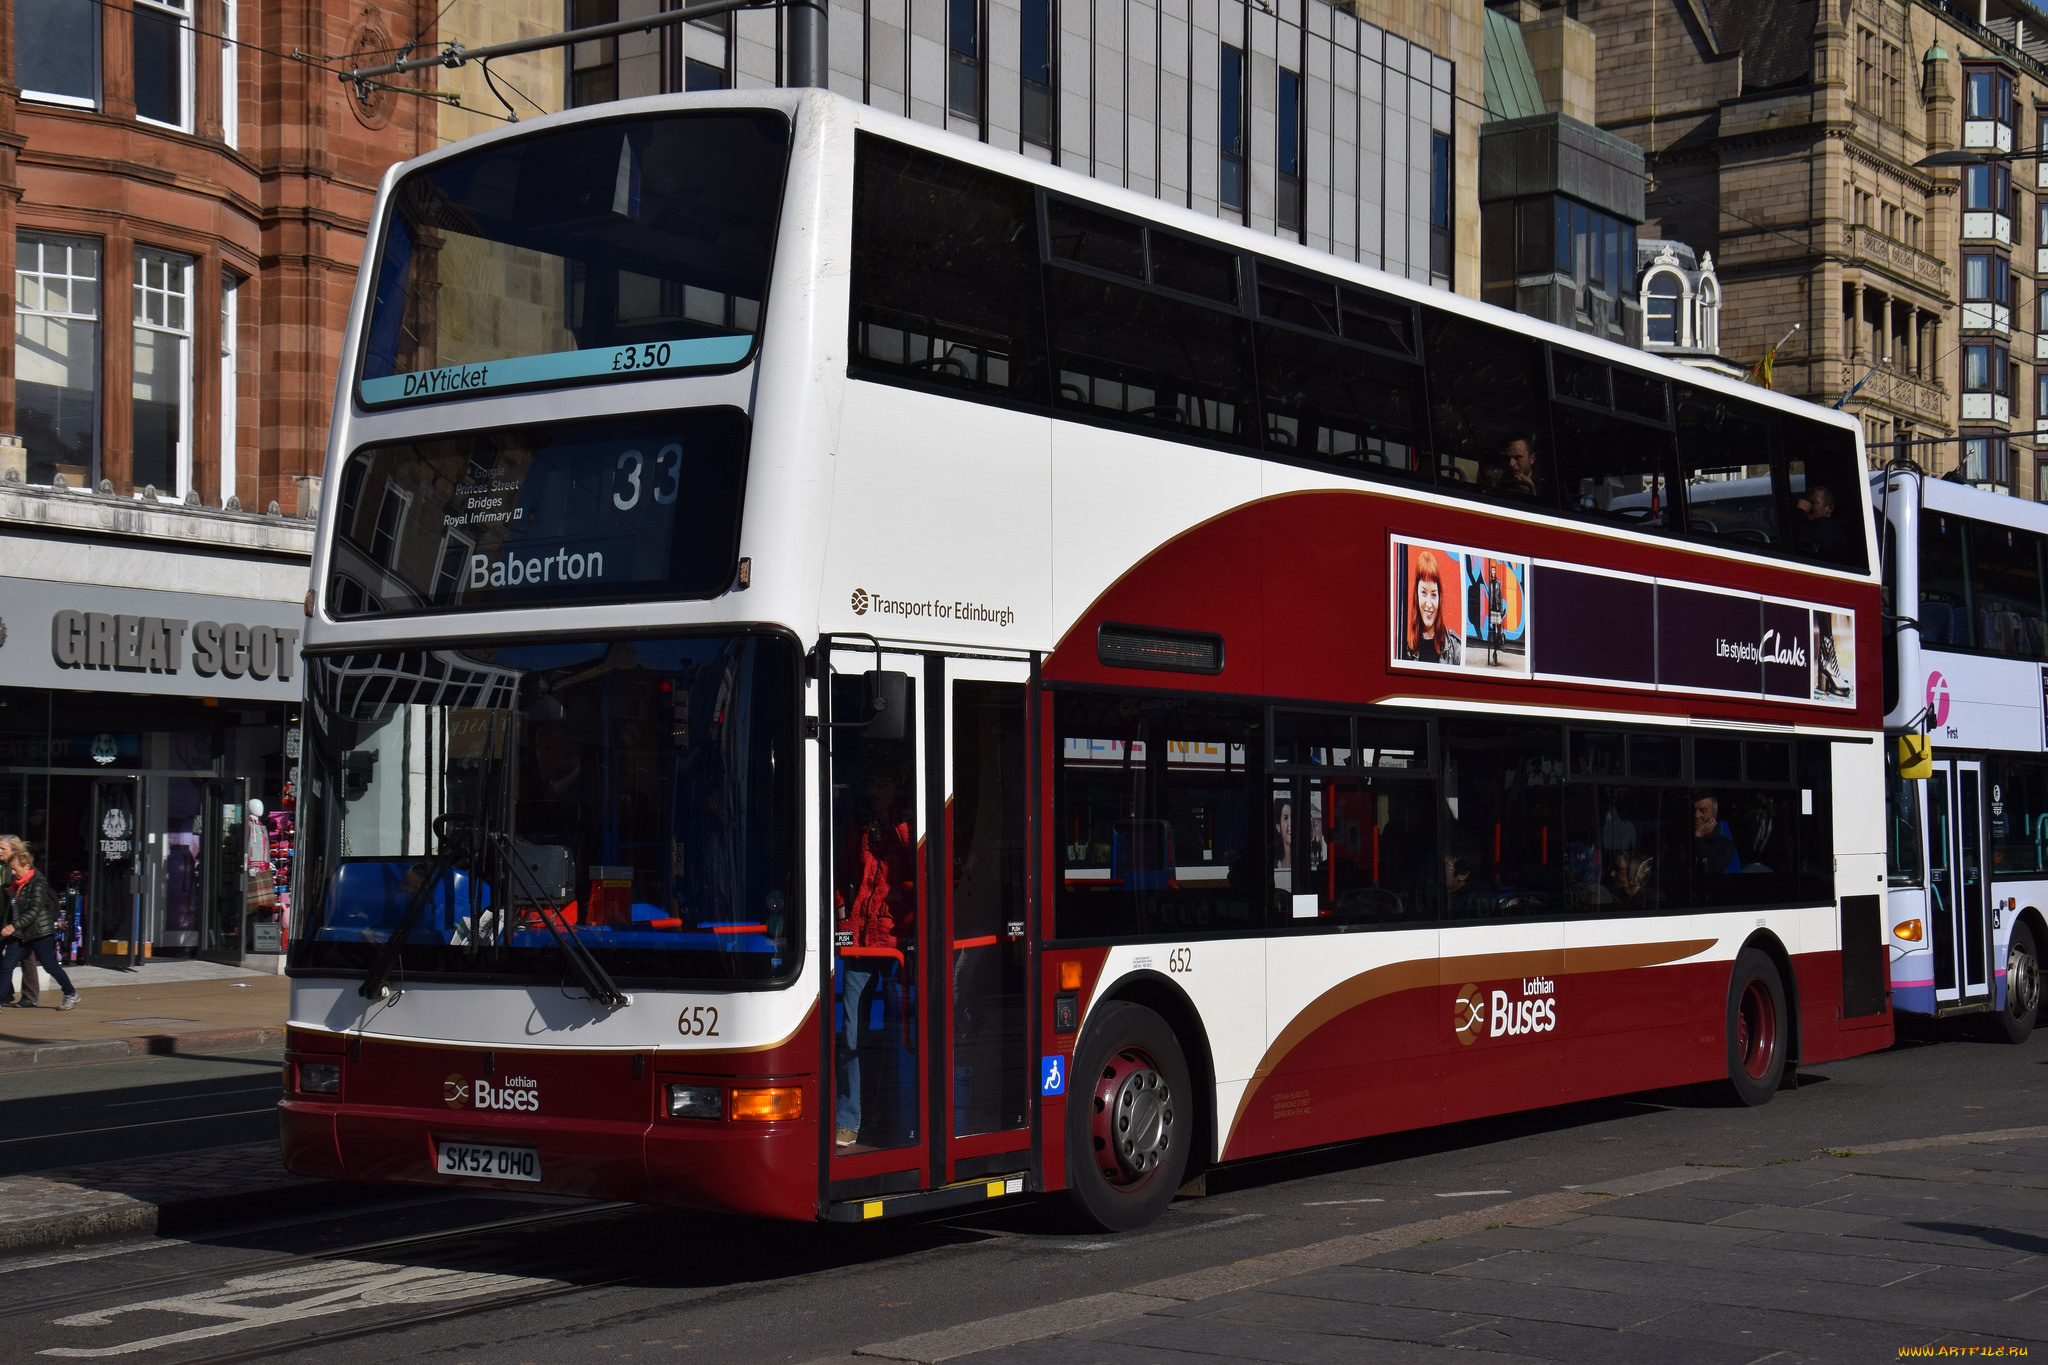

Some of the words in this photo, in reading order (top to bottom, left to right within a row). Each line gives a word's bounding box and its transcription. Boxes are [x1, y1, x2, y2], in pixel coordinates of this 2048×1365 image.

[403, 366, 488, 397] DAYticket
[612, 342, 670, 372] £3.50
[455, 482, 488, 495] Princes
[491, 479, 520, 492] Street
[474, 465, 505, 479] Gorgie
[611, 444, 683, 511] 33
[443, 514, 468, 527] Royal
[470, 510, 512, 524] Infirmary
[467, 496, 503, 510] Bridges
[470, 546, 603, 589] Baberton
[871, 594, 932, 619] Transport
[934, 599, 952, 618] for
[954, 601, 1014, 627] Edinburgh
[52, 608, 188, 674] GREAT
[192, 620, 299, 681] SCOT
[1716, 638, 1729, 658] Life
[1730, 641, 1750, 663] styled
[1751, 642, 1759, 665] by
[1759, 628, 1805, 667] Clarks
[1946, 726, 1958, 740] First
[1169, 947, 1192, 973] 652
[1523, 976, 1554, 995] Lothian
[677, 1006, 720, 1038] 652
[1490, 989, 1556, 1037] Buses
[475, 1080, 539, 1112] Buses
[504, 1075, 537, 1089] Lothian
[446, 1146, 493, 1175] SK52
[498, 1150, 533, 1176] OHO
